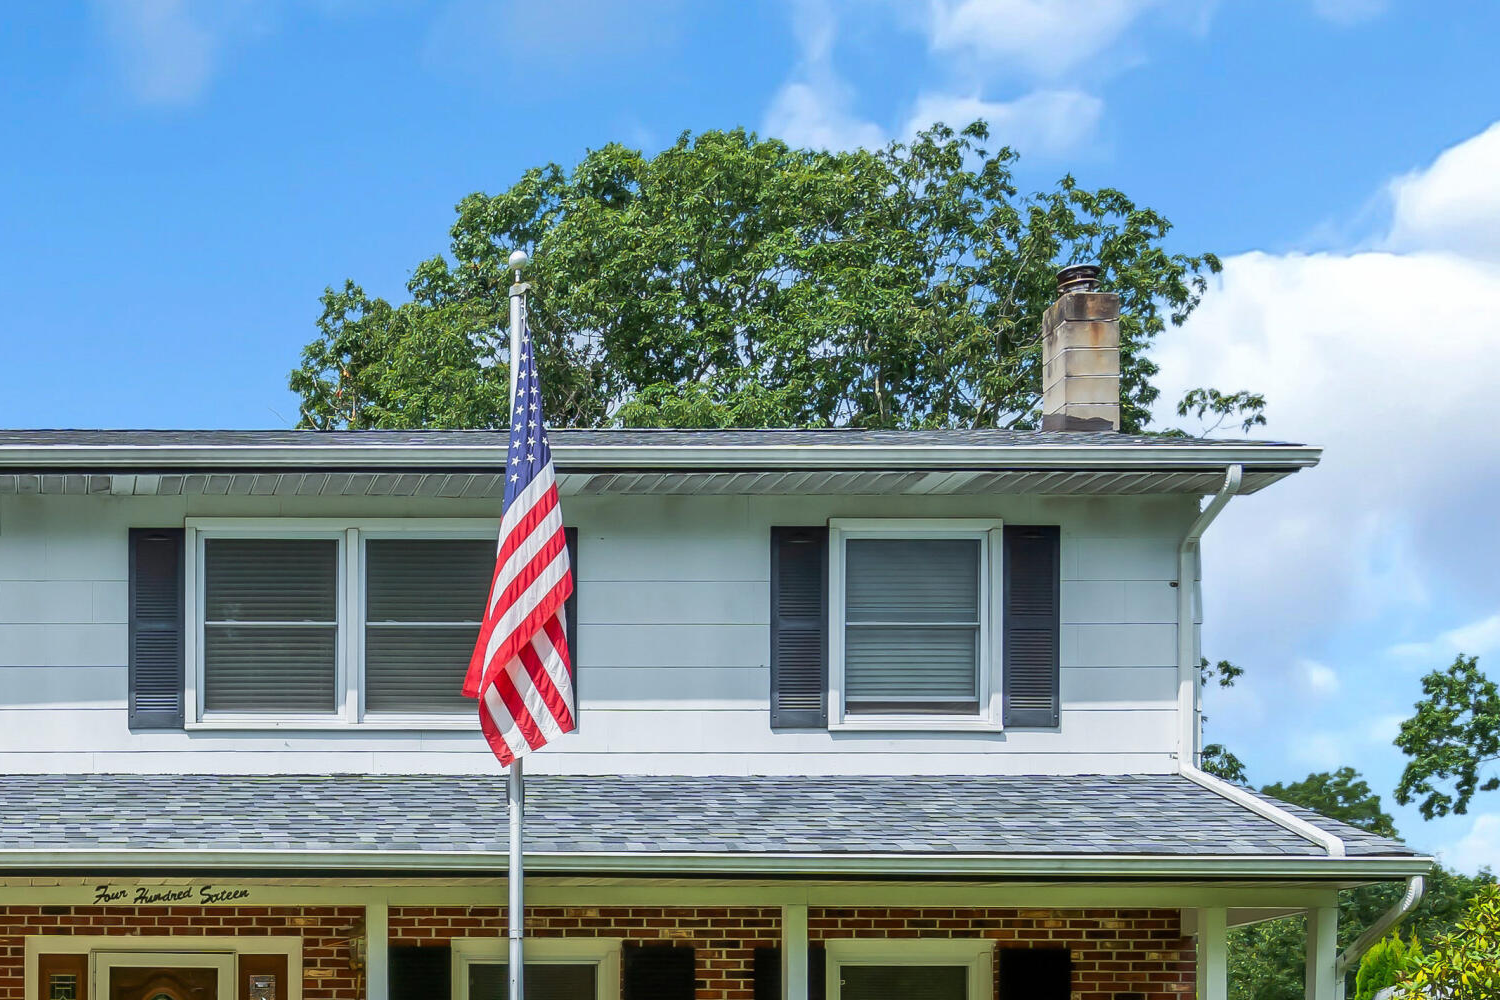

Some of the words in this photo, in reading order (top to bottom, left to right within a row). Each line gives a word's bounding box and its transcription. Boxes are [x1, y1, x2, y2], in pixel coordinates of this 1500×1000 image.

[93, 885, 128, 905] Four
[133, 887, 193, 904] Hundred
[199, 885, 250, 905] Sixteen
